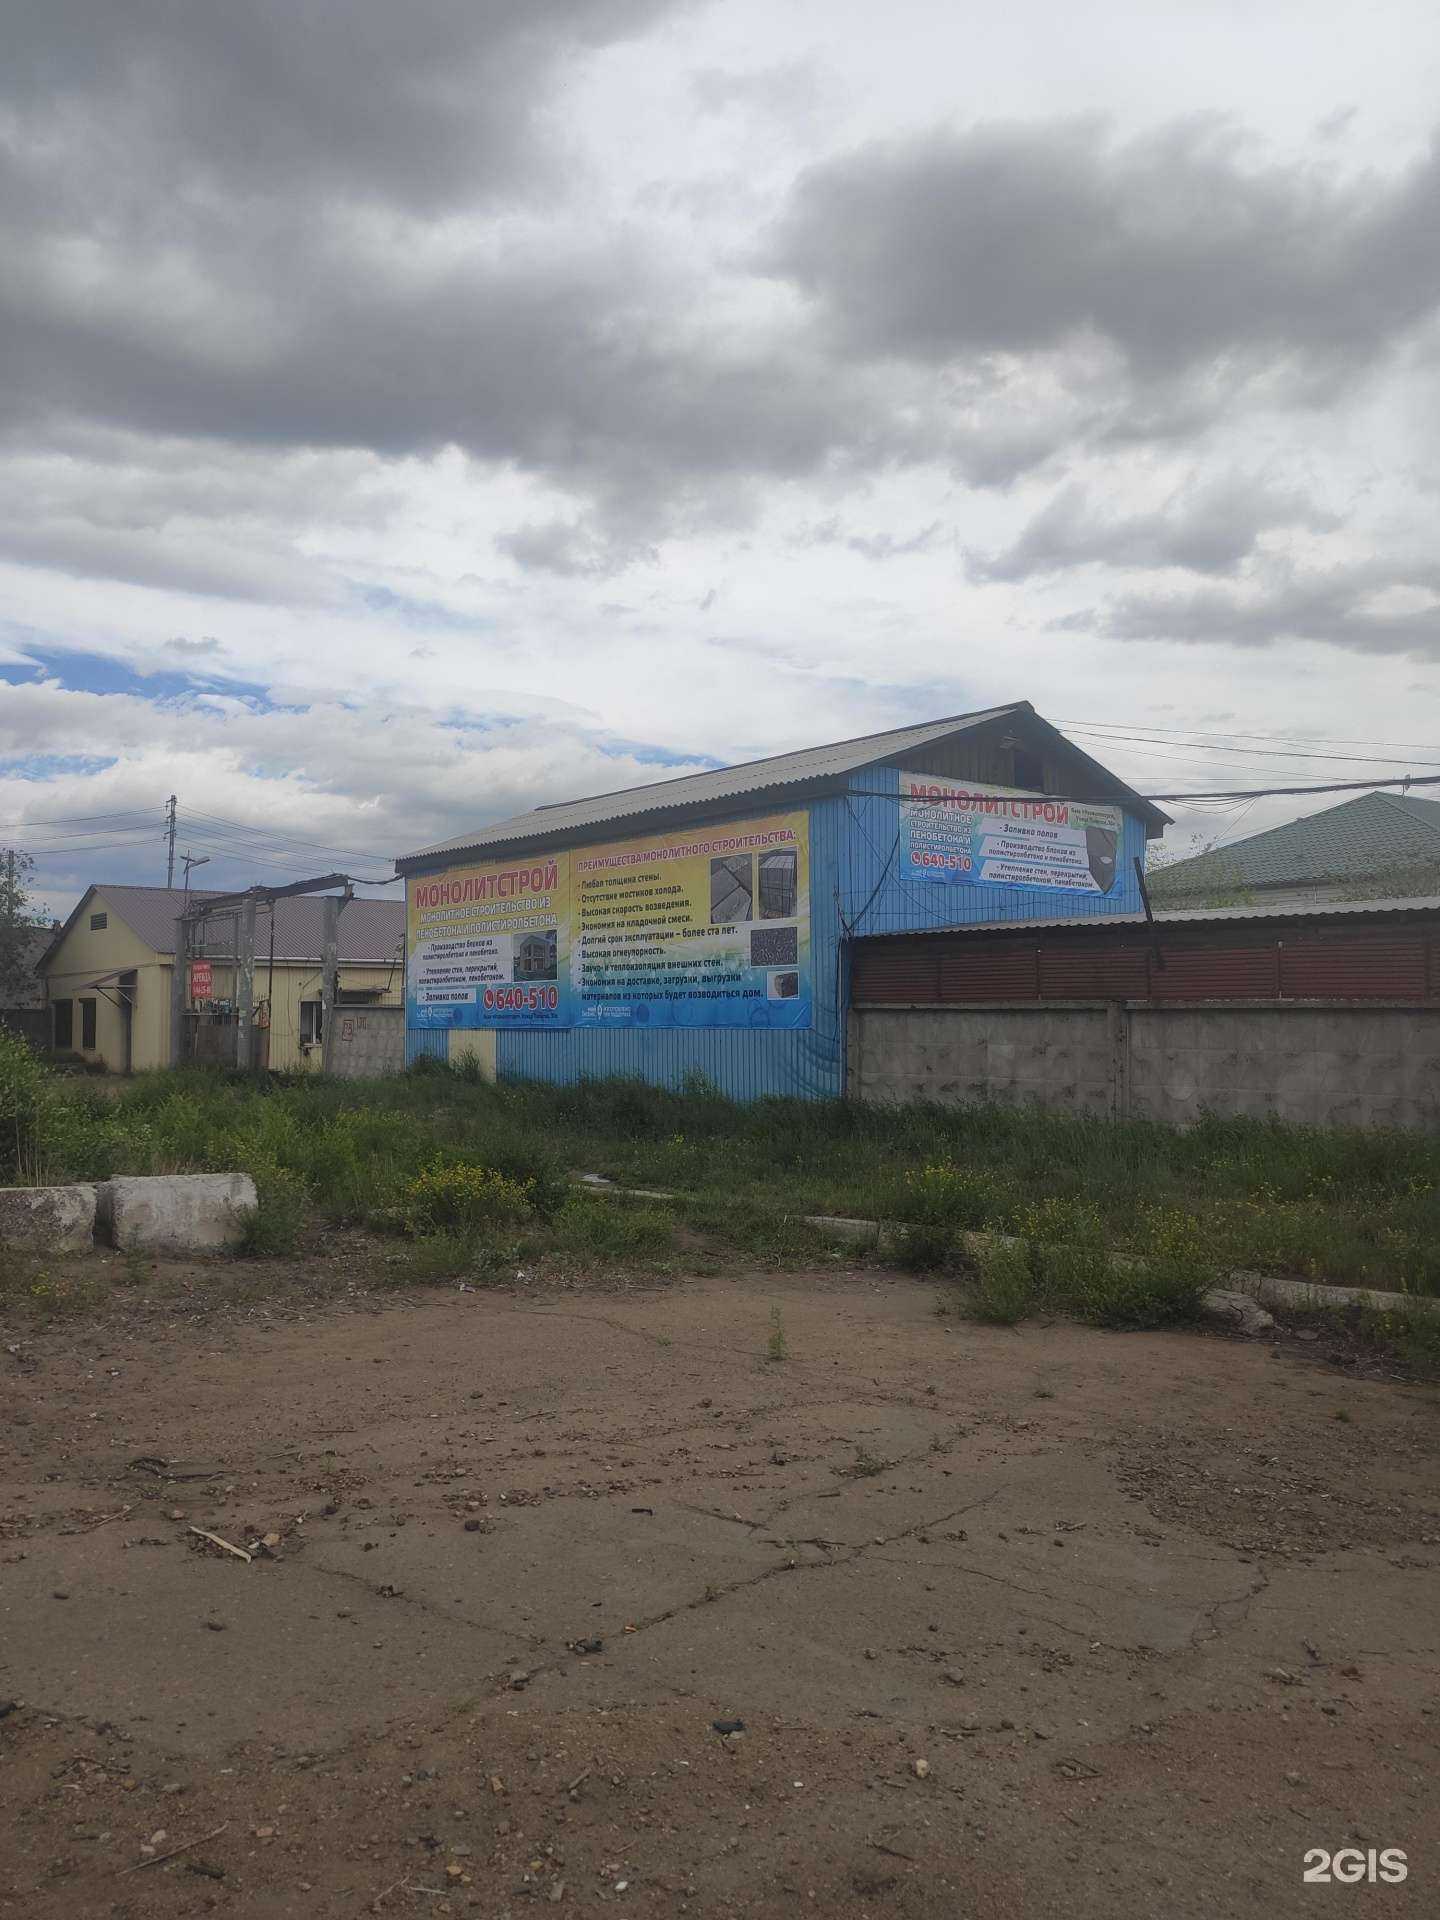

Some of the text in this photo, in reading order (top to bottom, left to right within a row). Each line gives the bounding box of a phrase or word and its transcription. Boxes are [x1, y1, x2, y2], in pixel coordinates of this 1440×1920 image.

[910, 808, 972, 824] МОНОЛИТНОЕ
[910, 830, 965, 844] ПЕНОБЕТОНА
[1003, 824, 1058, 839] Заливка полов
[577, 854, 641, 872] ПРЕИМУЩЕСТВА
[642, 842, 710, 863] МОНОЛИТНОГО
[922, 853, 972, 871] 640-510
[416, 859, 558, 909] МОНОЛИТСТРОЙ
[581, 880, 604, 889] Любая
[605, 876, 636, 887] толщина
[581, 894, 618, 903] Отсутствие
[620, 888, 653, 898] мостиков
[421, 897, 551, 924] МОНОЛИТНОЕ СТРОИТЕЛЬСТВО ИЗ
[581, 908, 610, 917] Высокая
[612, 905, 643, 915] скорость
[581, 922, 615, 931] Экономия
[626, 917, 666, 929] кладочной
[581, 935, 606, 945] Долгий
[608, 936, 623, 944] срок
[624, 932, 674, 942] эксплуатации
[682, 928, 705, 937] более
[581, 950, 612, 958] Высокая
[610, 962, 666, 972] теплоизоляция
[667, 960, 701, 969] внешних
[581, 978, 615, 986] Экономия
[702, 974, 741, 984] выгрузки
[495, 986, 558, 1010] 640-510
[632, 993, 663, 1002] которых
[665, 990, 686, 1000] будет
[688, 990, 740, 999] возводиться
